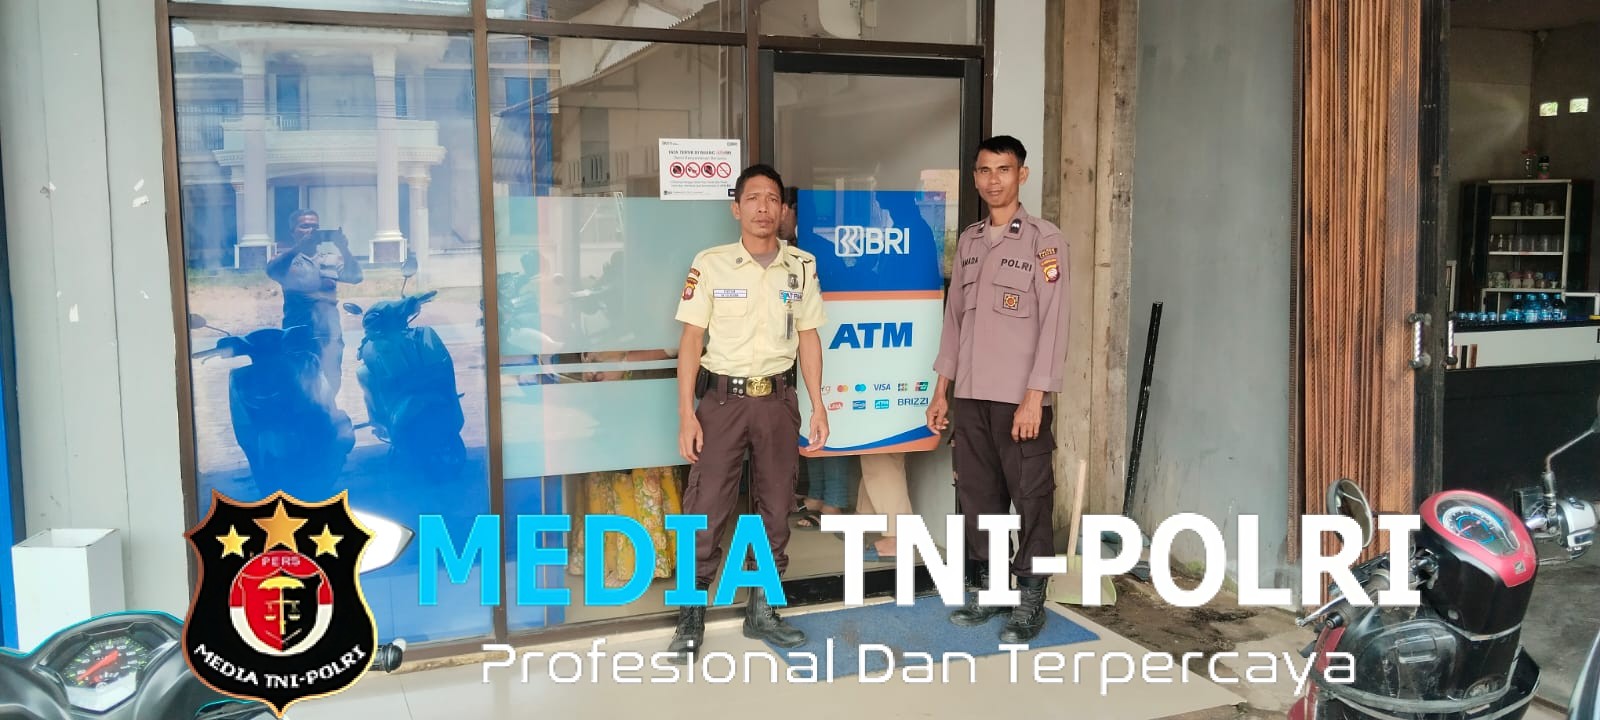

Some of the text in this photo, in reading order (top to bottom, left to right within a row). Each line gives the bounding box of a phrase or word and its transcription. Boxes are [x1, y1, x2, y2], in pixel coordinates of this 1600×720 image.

[866, 227, 910, 255] BRI
[1000, 258, 1033, 272] POLRI
[828, 322, 914, 350] ATM
[873, 383, 891, 391] VISA
[897, 397, 929, 406] BRIZZI
